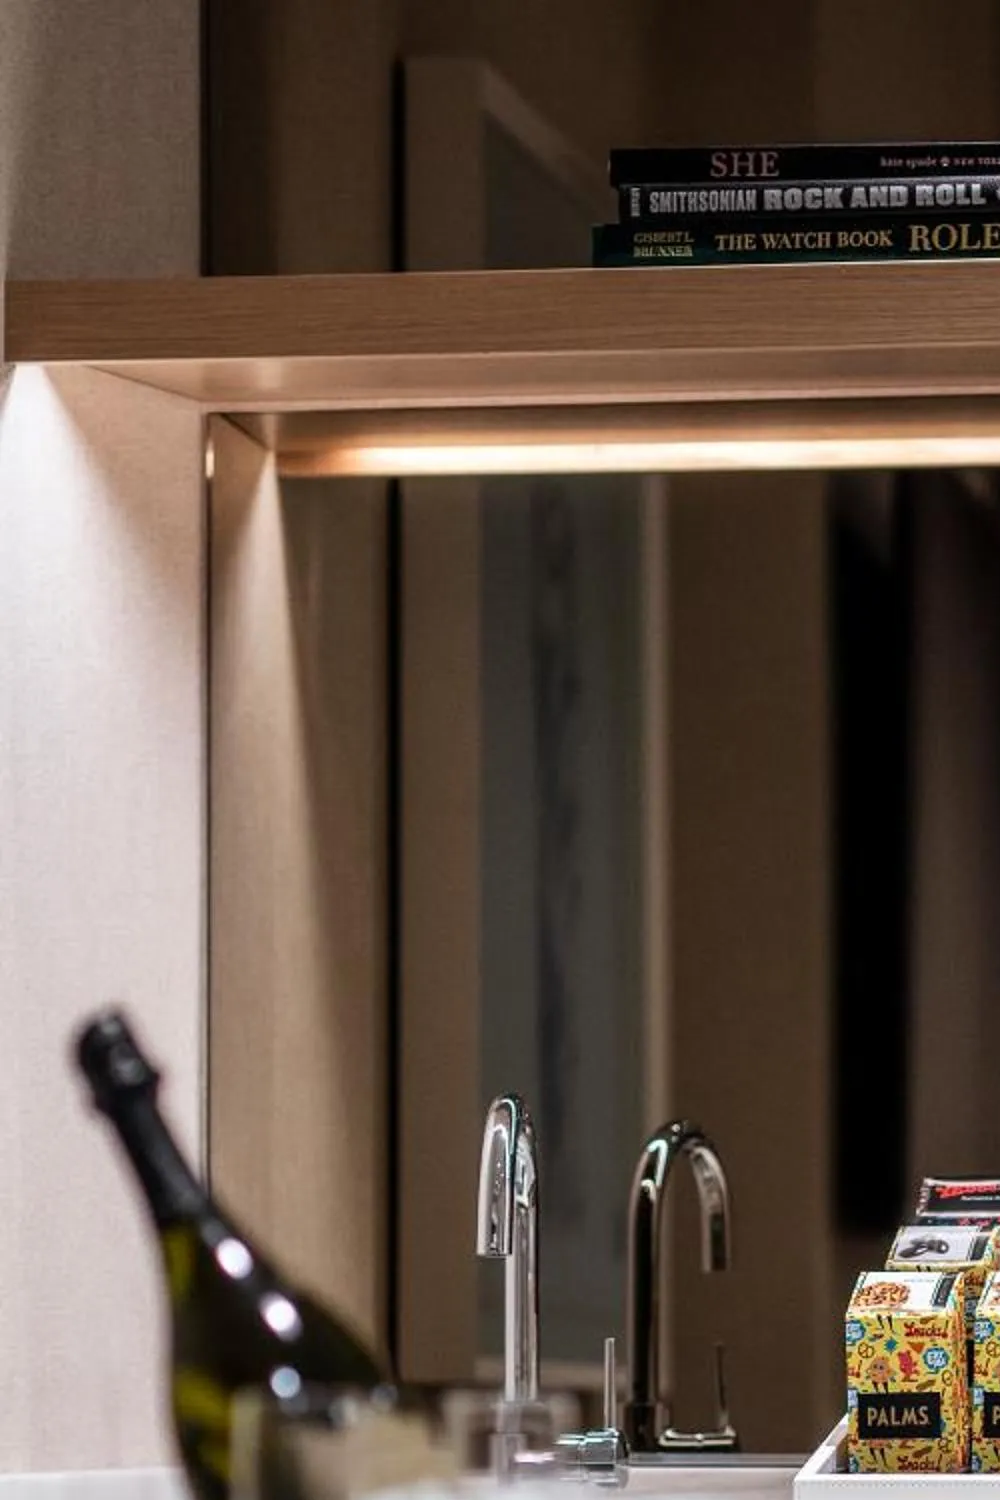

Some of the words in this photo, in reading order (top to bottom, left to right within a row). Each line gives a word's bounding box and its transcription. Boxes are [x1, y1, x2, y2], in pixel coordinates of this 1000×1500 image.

[710, 152, 780, 178] SHE
[649, 190, 758, 214] SMITHSONIAN
[763, 187, 844, 211] ROCK
[848, 185, 909, 209] AND
[915, 183, 987, 207] ROLL
[715, 234, 757, 251] THE
[760, 231, 832, 250] WATCH
[836, 229, 893, 248] BOOK
[867, 1404, 930, 1427] PALMS
